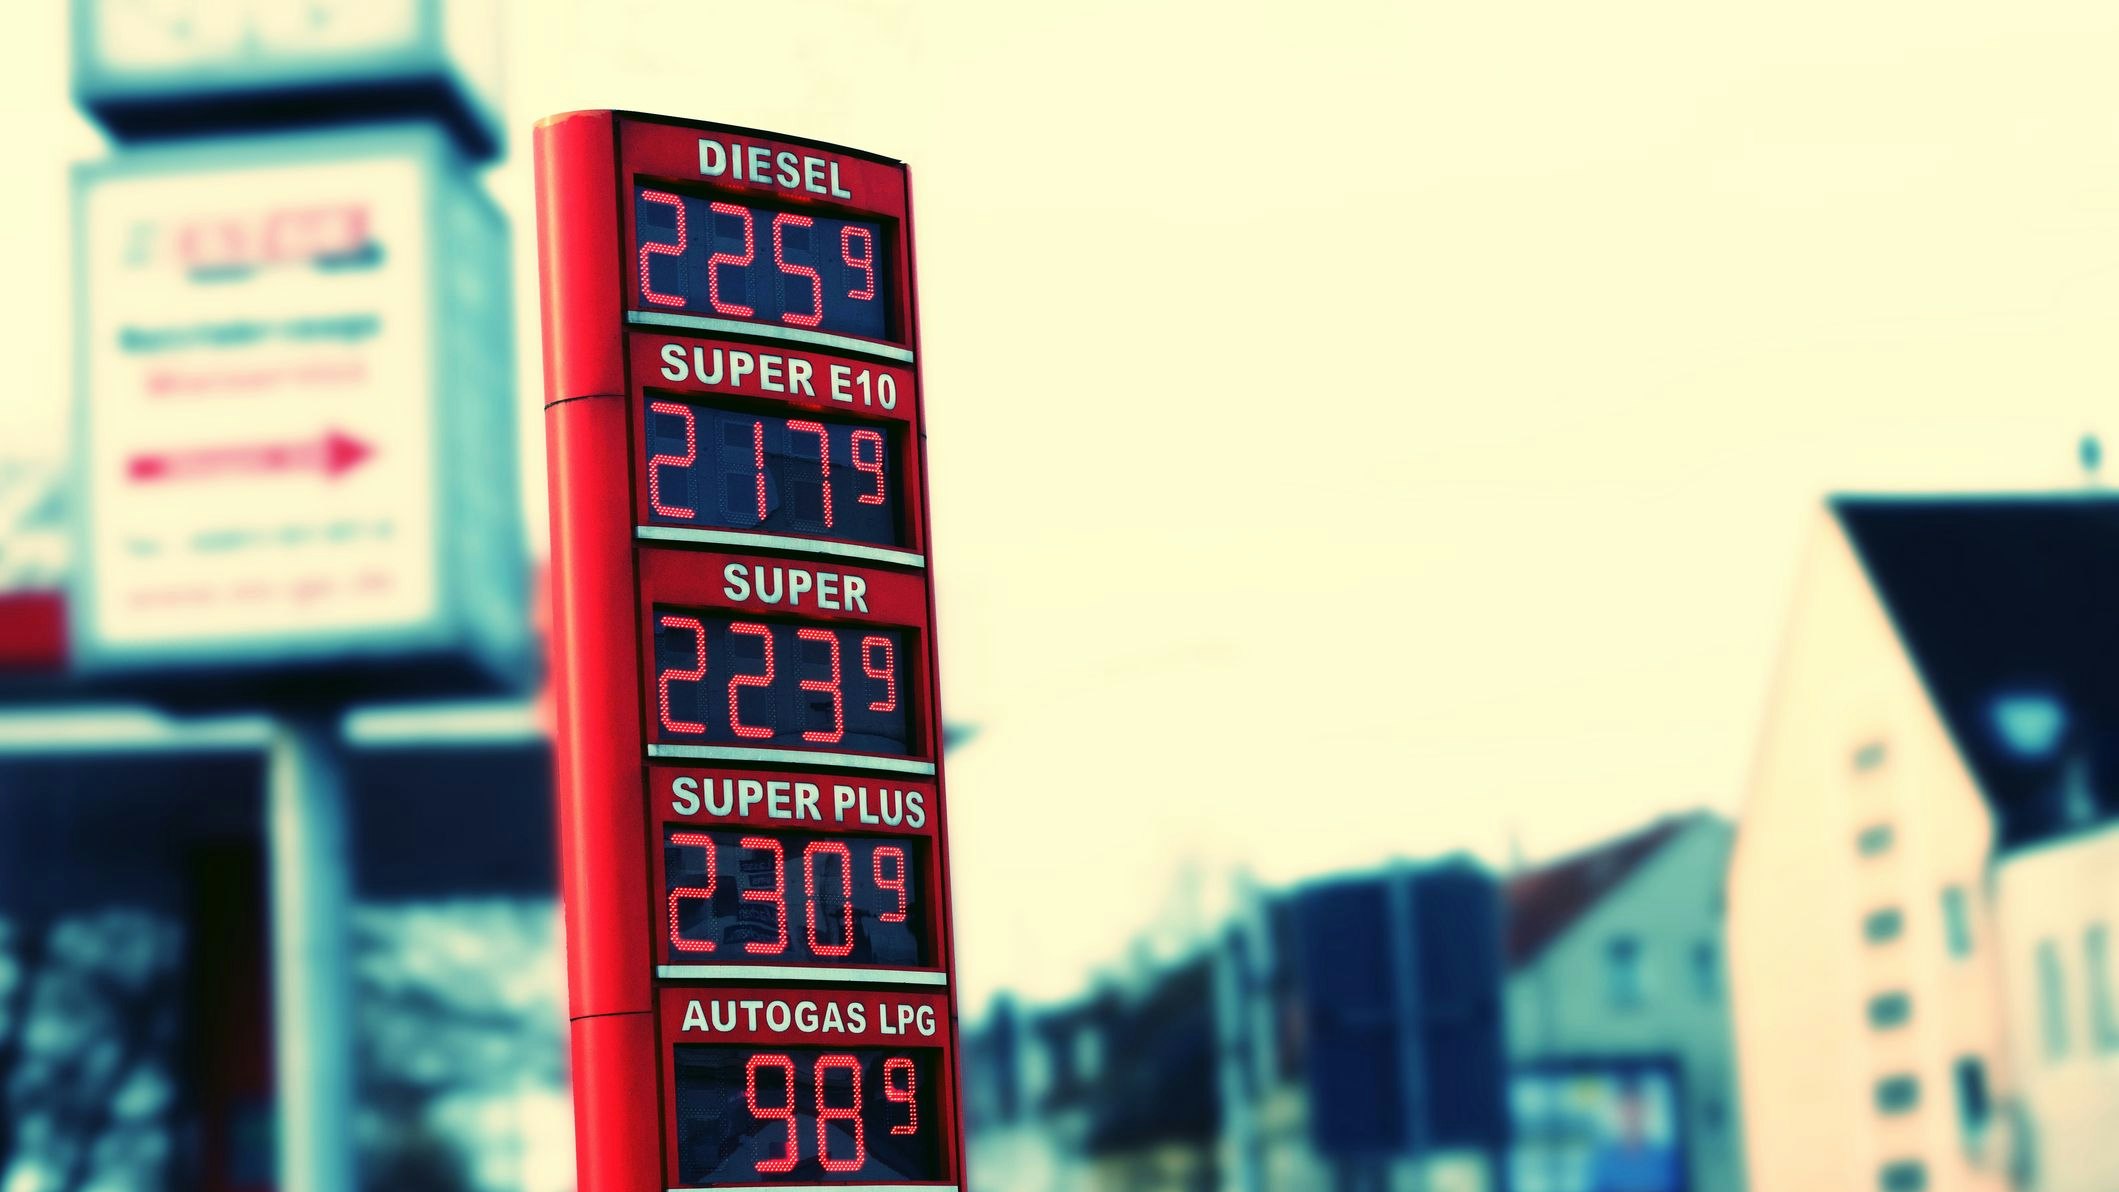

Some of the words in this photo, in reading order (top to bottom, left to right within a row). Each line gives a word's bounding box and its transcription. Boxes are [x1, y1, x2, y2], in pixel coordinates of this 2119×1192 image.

[698, 138, 851, 199] DIESEL
[660, 343, 816, 397] SUPER
[830, 364, 897, 410] E10
[723, 563, 869, 612] SUPER
[671, 776, 821, 820] SUPER
[833, 784, 926, 829] PLUS
[681, 1000, 867, 1034] AUTOGAS
[879, 1003, 936, 1037] LPG
